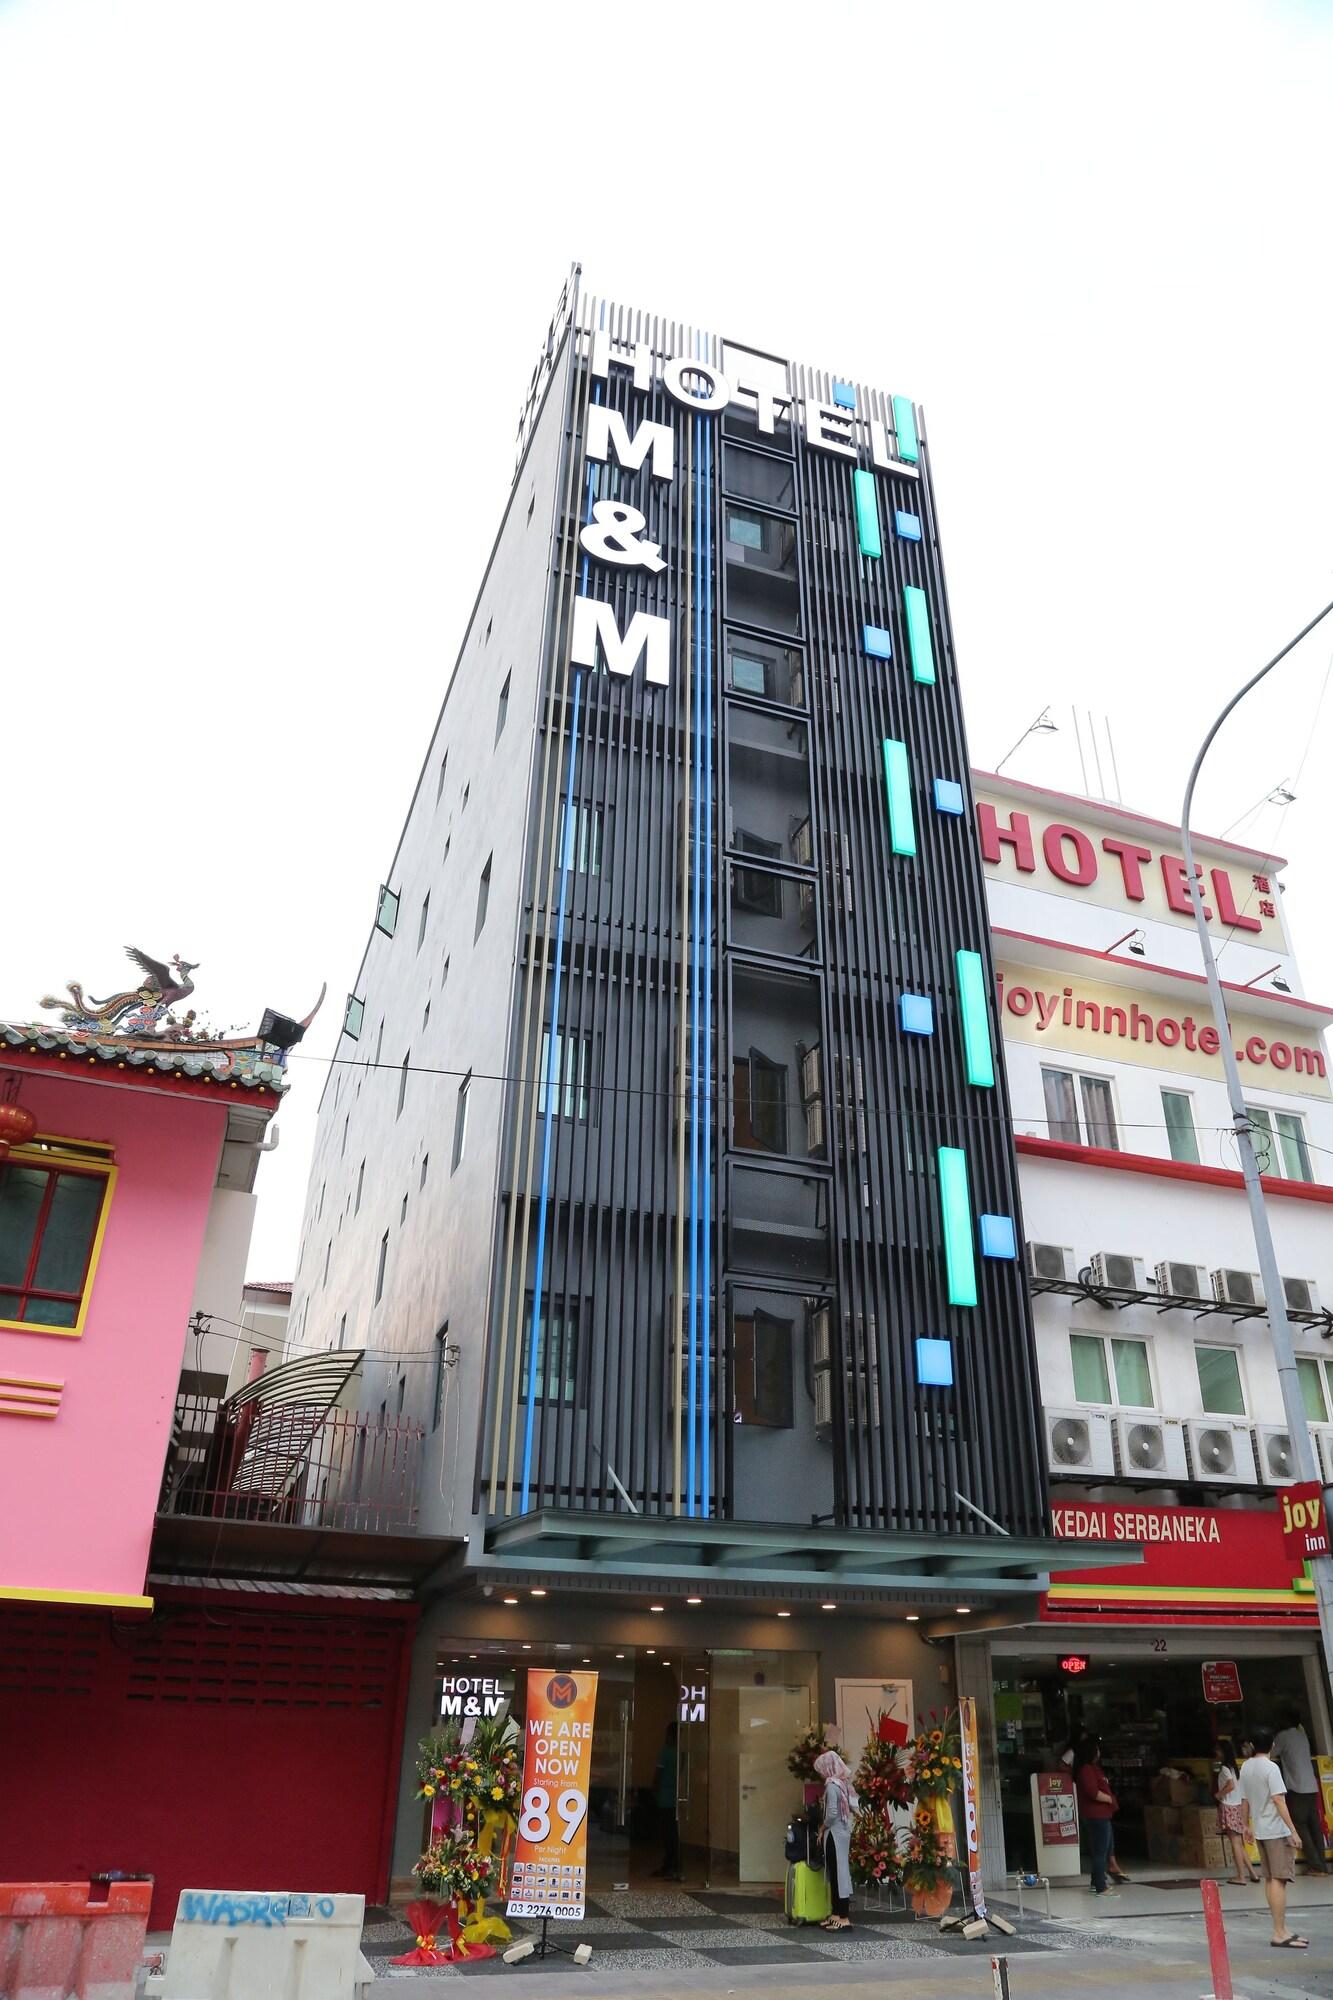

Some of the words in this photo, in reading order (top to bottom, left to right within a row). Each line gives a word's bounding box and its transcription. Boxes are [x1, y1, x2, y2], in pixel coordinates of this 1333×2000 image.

[590, 329, 920, 480] HOTEL
[976, 802, 1263, 933] HOTEL
[1282, 1495, 1320, 1534] joy
[1051, 1509, 1107, 1539] KEDAI
[1113, 1512, 1221, 1543] SERBANEKA
[1305, 1533, 1326, 1552] inn
[1154, 1639, 1167, 1652] 22
[1062, 1660, 1086, 1671] OPEN
[442, 1677, 505, 1695] HOTEL
[440, 1695, 505, 1717] M&M
[529, 1719, 553, 1737] WE
[557, 1721, 592, 1739] ARE
[535, 1738, 582, 1757] OPEN
[535, 1757, 579, 1776] NOW
[533, 1777, 559, 1788] Starting
[560, 1779, 578, 1788] From
[519, 1786, 587, 1846] 89
[510, 1903, 524, 1914] 03
[526, 1904, 552, 1916] 2276
[555, 1906, 581, 1917] 0005
